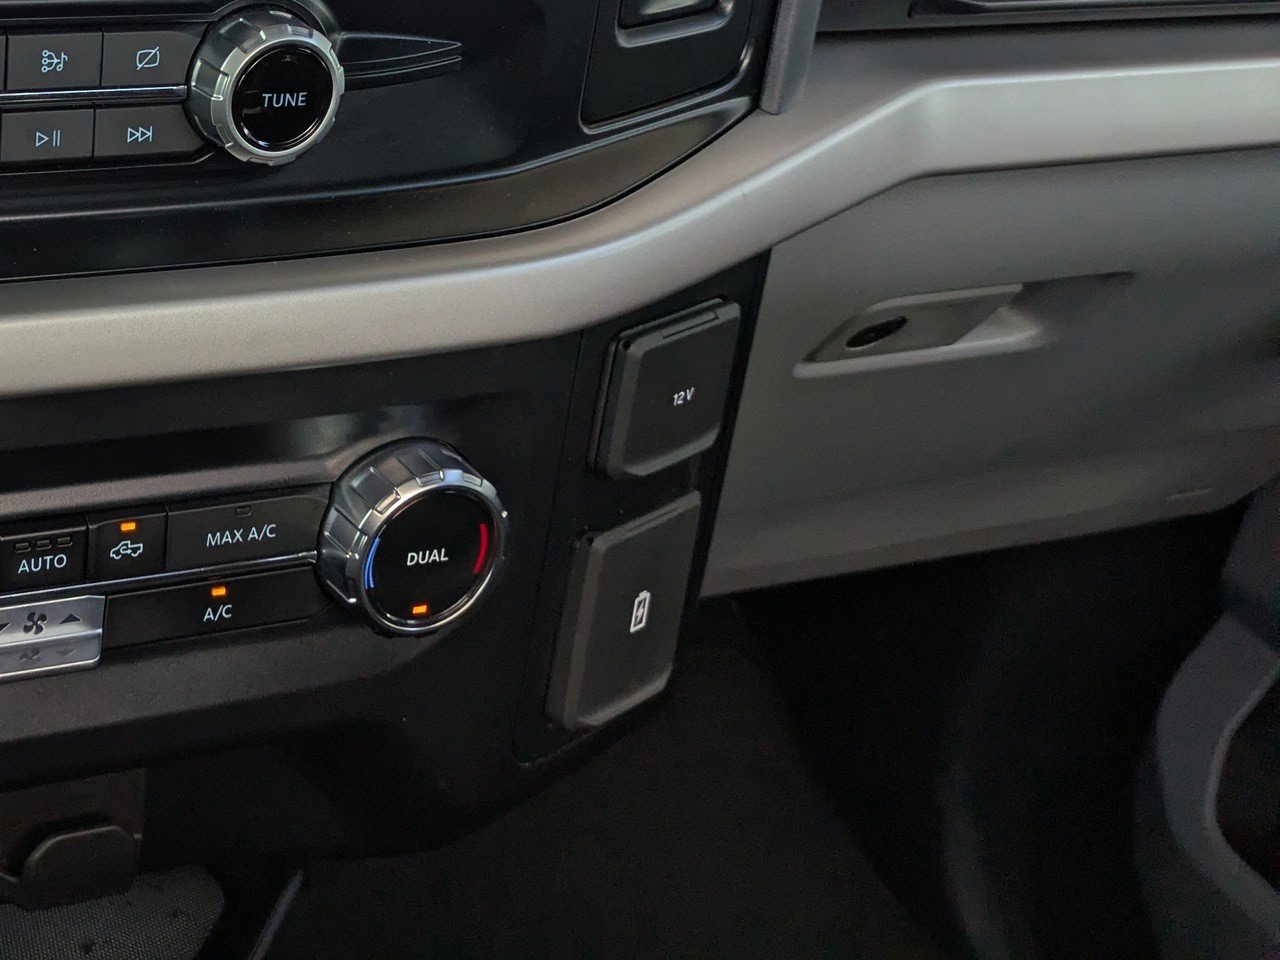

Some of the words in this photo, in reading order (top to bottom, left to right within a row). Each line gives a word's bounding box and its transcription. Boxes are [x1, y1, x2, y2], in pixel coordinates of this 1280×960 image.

[261, 91, 308, 109] TUNE
[206, 528, 243, 547] MAX
[247, 524, 278, 543] A/C
[17, 553, 67, 574] AUTO
[406, 548, 449, 566] DUAL
[203, 604, 233, 622] A/C
